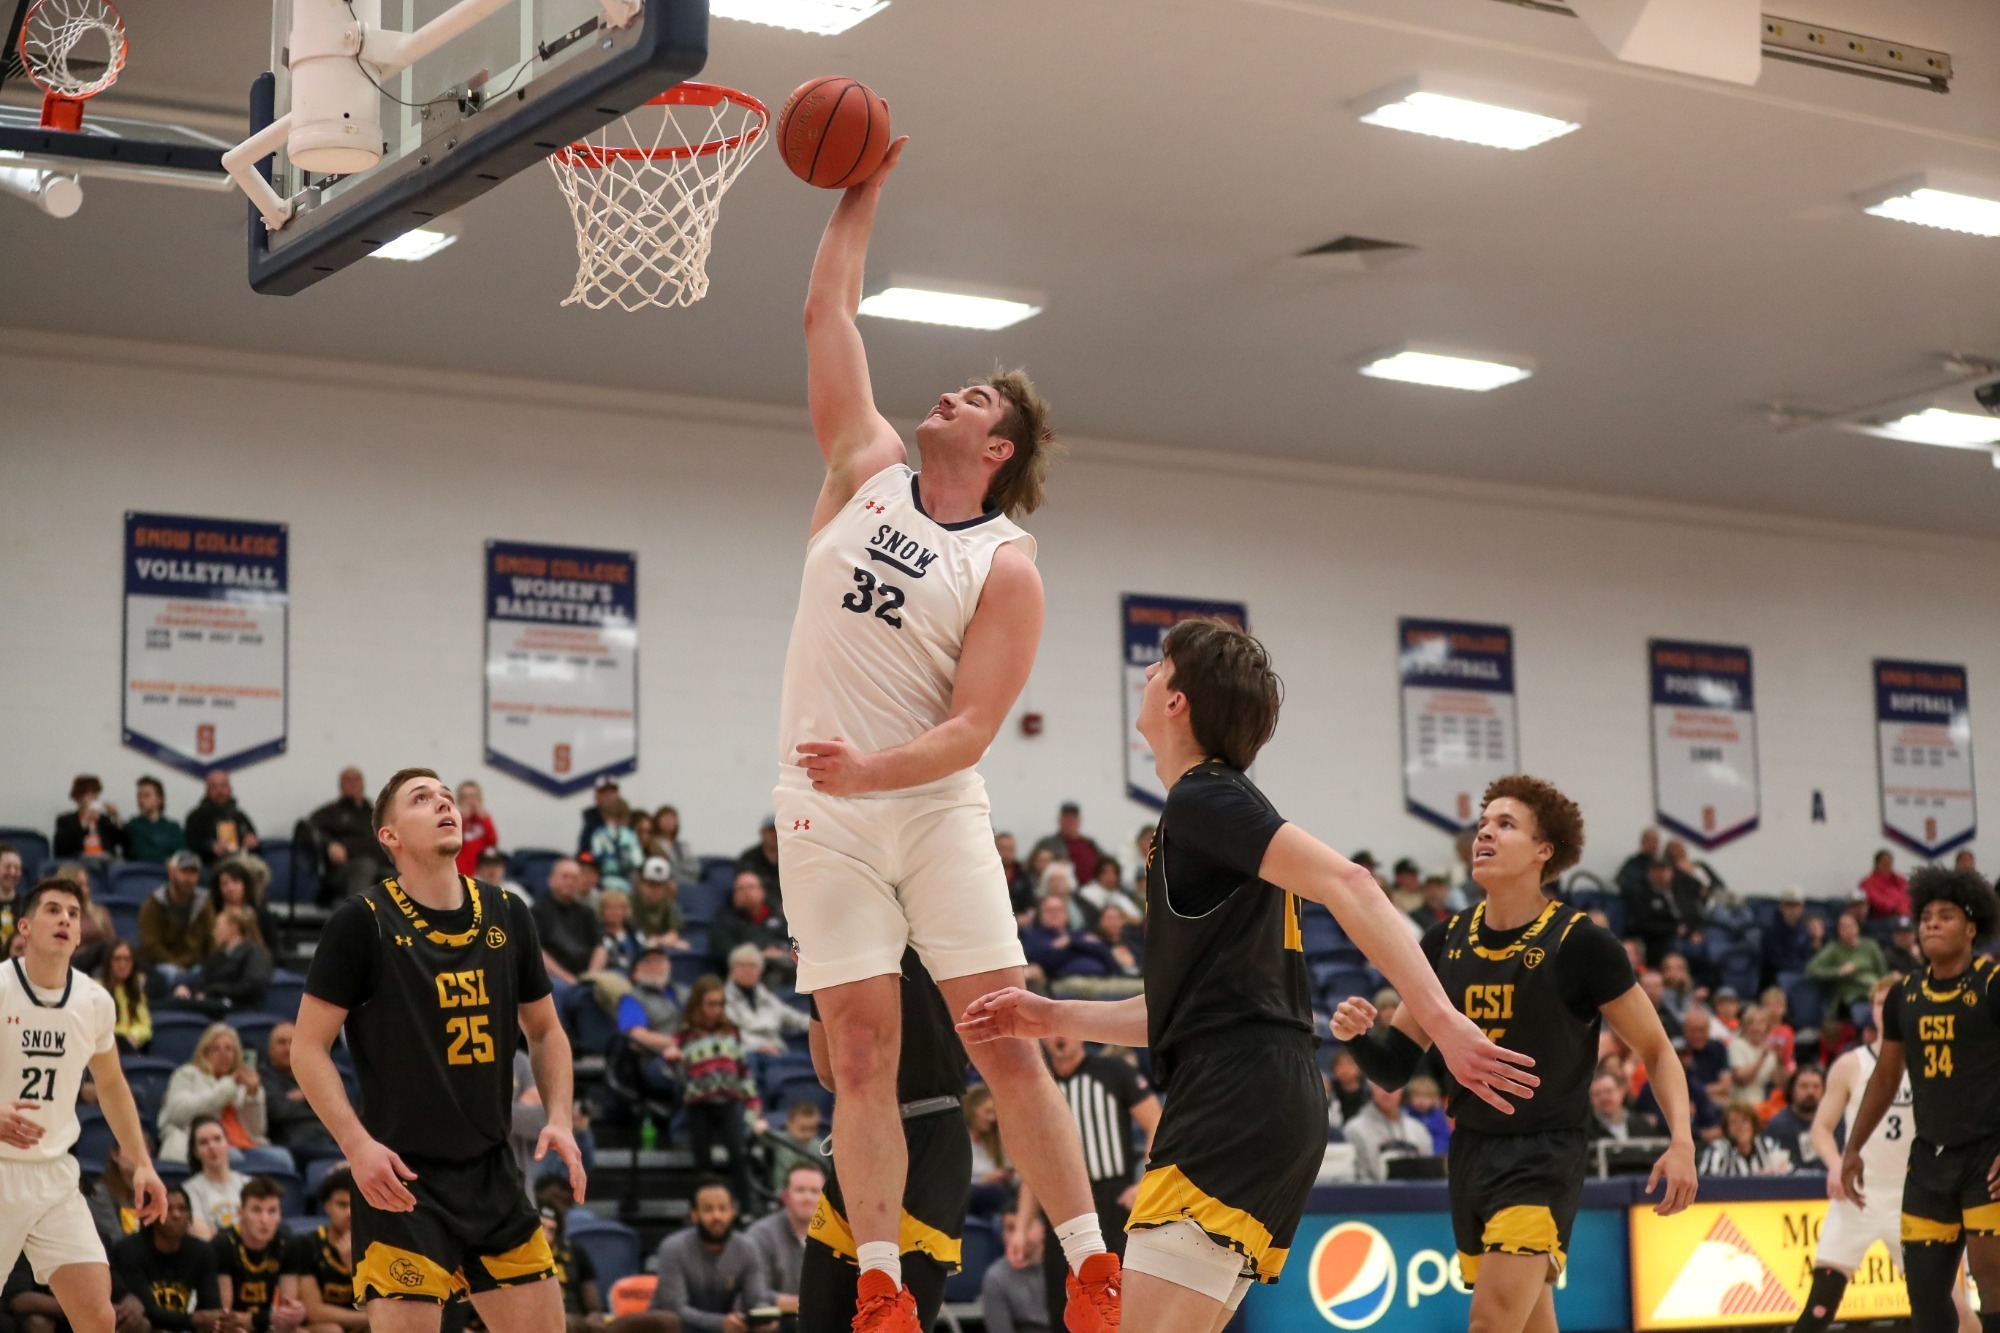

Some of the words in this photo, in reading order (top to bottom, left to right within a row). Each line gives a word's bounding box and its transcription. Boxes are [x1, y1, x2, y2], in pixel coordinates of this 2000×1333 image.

[134, 527, 191, 550] SNOW
[194, 532, 279, 557] COLLEGE
[870, 524, 939, 570] SNOW
[134, 557, 279, 588] VOLLEYBALL
[511, 576, 613, 604] WOMEN'S
[842, 566, 906, 630] 32
[495, 596, 627, 626] BASKETBALL
[435, 969, 489, 1009] CSI
[1465, 984, 1515, 1019] CSI
[22, 1030, 66, 1049] SNOW
[446, 1014, 495, 1065] 25
[1918, 1014, 1956, 1041] CSI
[1924, 1044, 1954, 1079] 34
[20, 1067, 57, 1101] 21
[1886, 1115, 1902, 1141] 3
[400, 1272, 424, 1287] CSI
